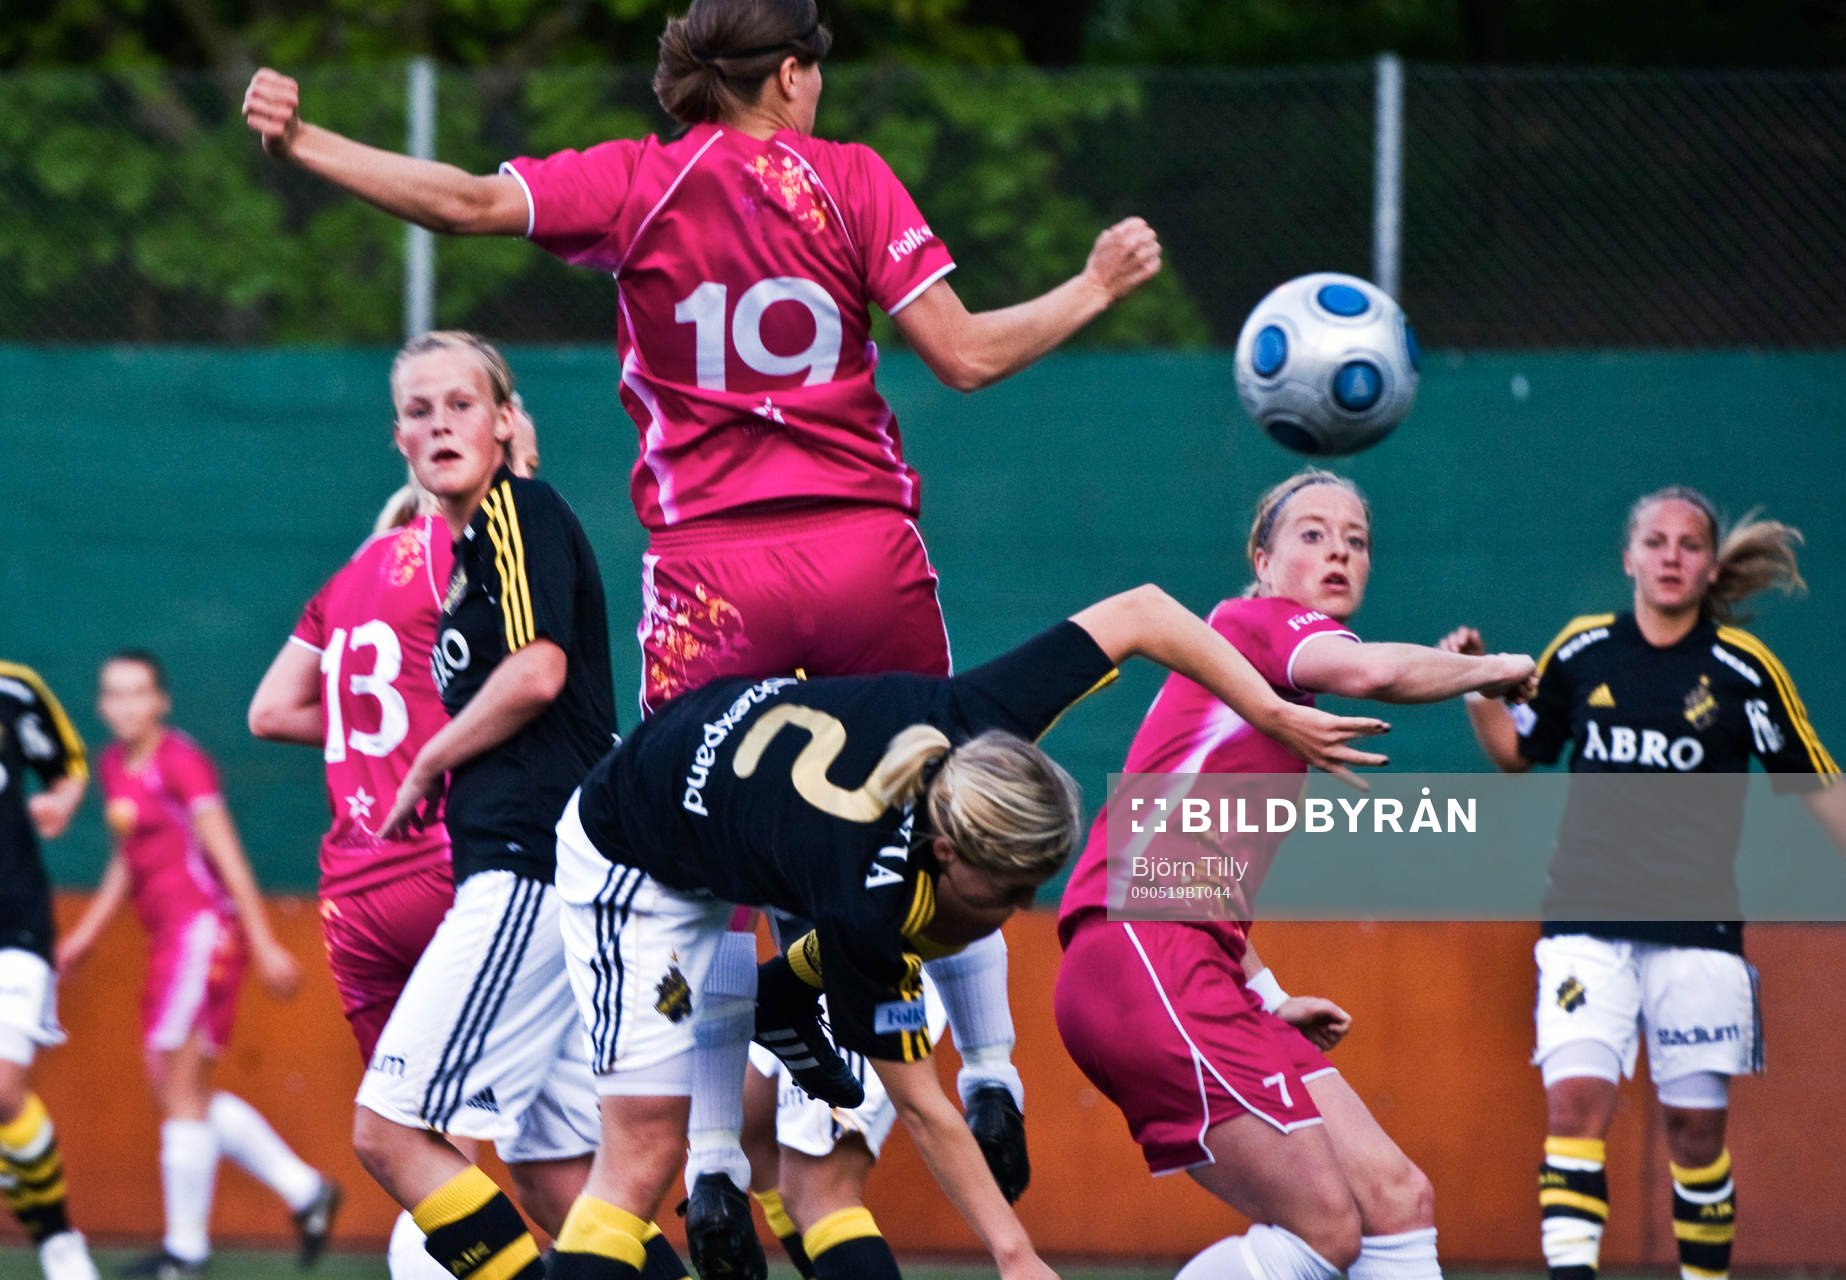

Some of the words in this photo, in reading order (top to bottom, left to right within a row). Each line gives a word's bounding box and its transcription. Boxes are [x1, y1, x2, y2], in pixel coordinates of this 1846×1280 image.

[674, 275, 843, 392] 19
[319, 619, 409, 763] 13
[732, 703, 890, 823] 2
[1262, 1072, 1294, 1109] 7
